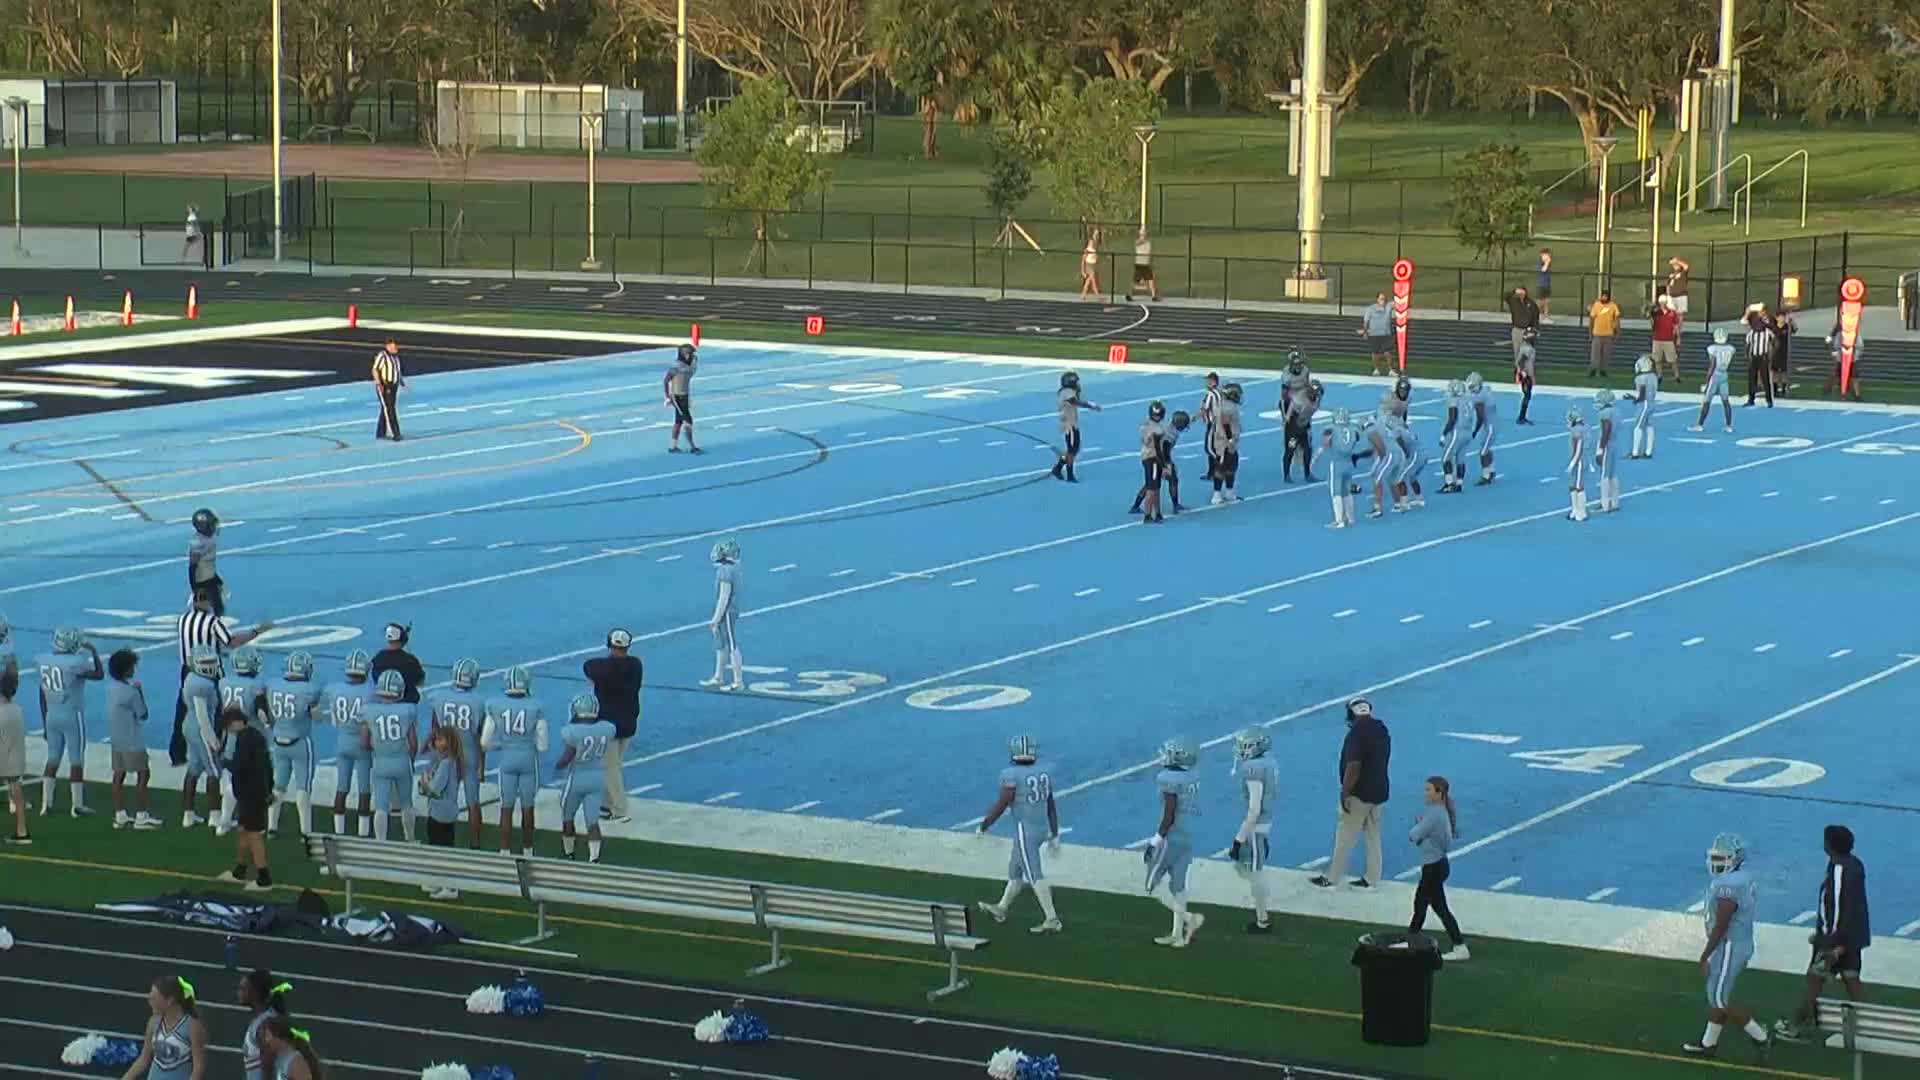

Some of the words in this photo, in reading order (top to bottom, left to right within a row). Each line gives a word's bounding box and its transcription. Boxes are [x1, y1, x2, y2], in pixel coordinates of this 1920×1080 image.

[40, 664, 64, 692] 50
[271, 691, 296, 720] 55
[335, 696, 362, 723] 84
[443, 702, 471, 730] 58
[375, 714, 401, 741] 16
[501, 708, 527, 736] 14
